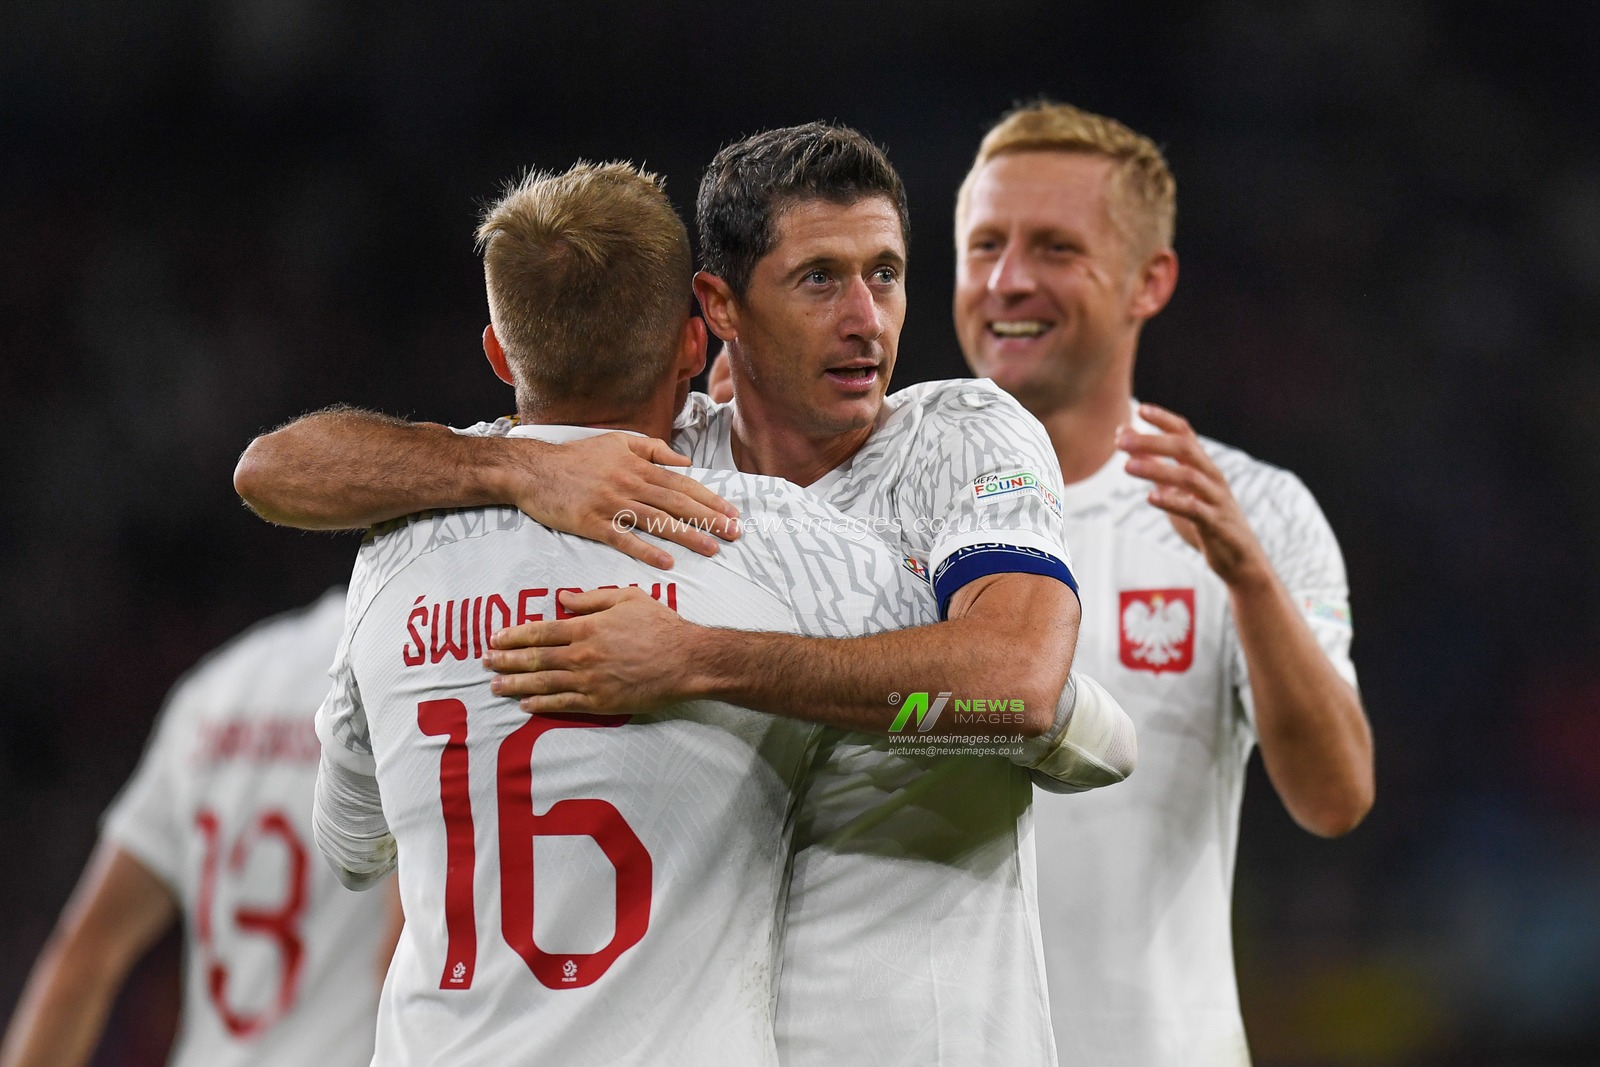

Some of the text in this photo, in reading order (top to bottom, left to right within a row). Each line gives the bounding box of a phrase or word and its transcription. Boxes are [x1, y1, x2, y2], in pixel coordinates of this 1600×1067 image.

[973, 475, 998, 485] UEFA
[195, 807, 309, 1042] 13
[417, 697, 653, 990] 16
